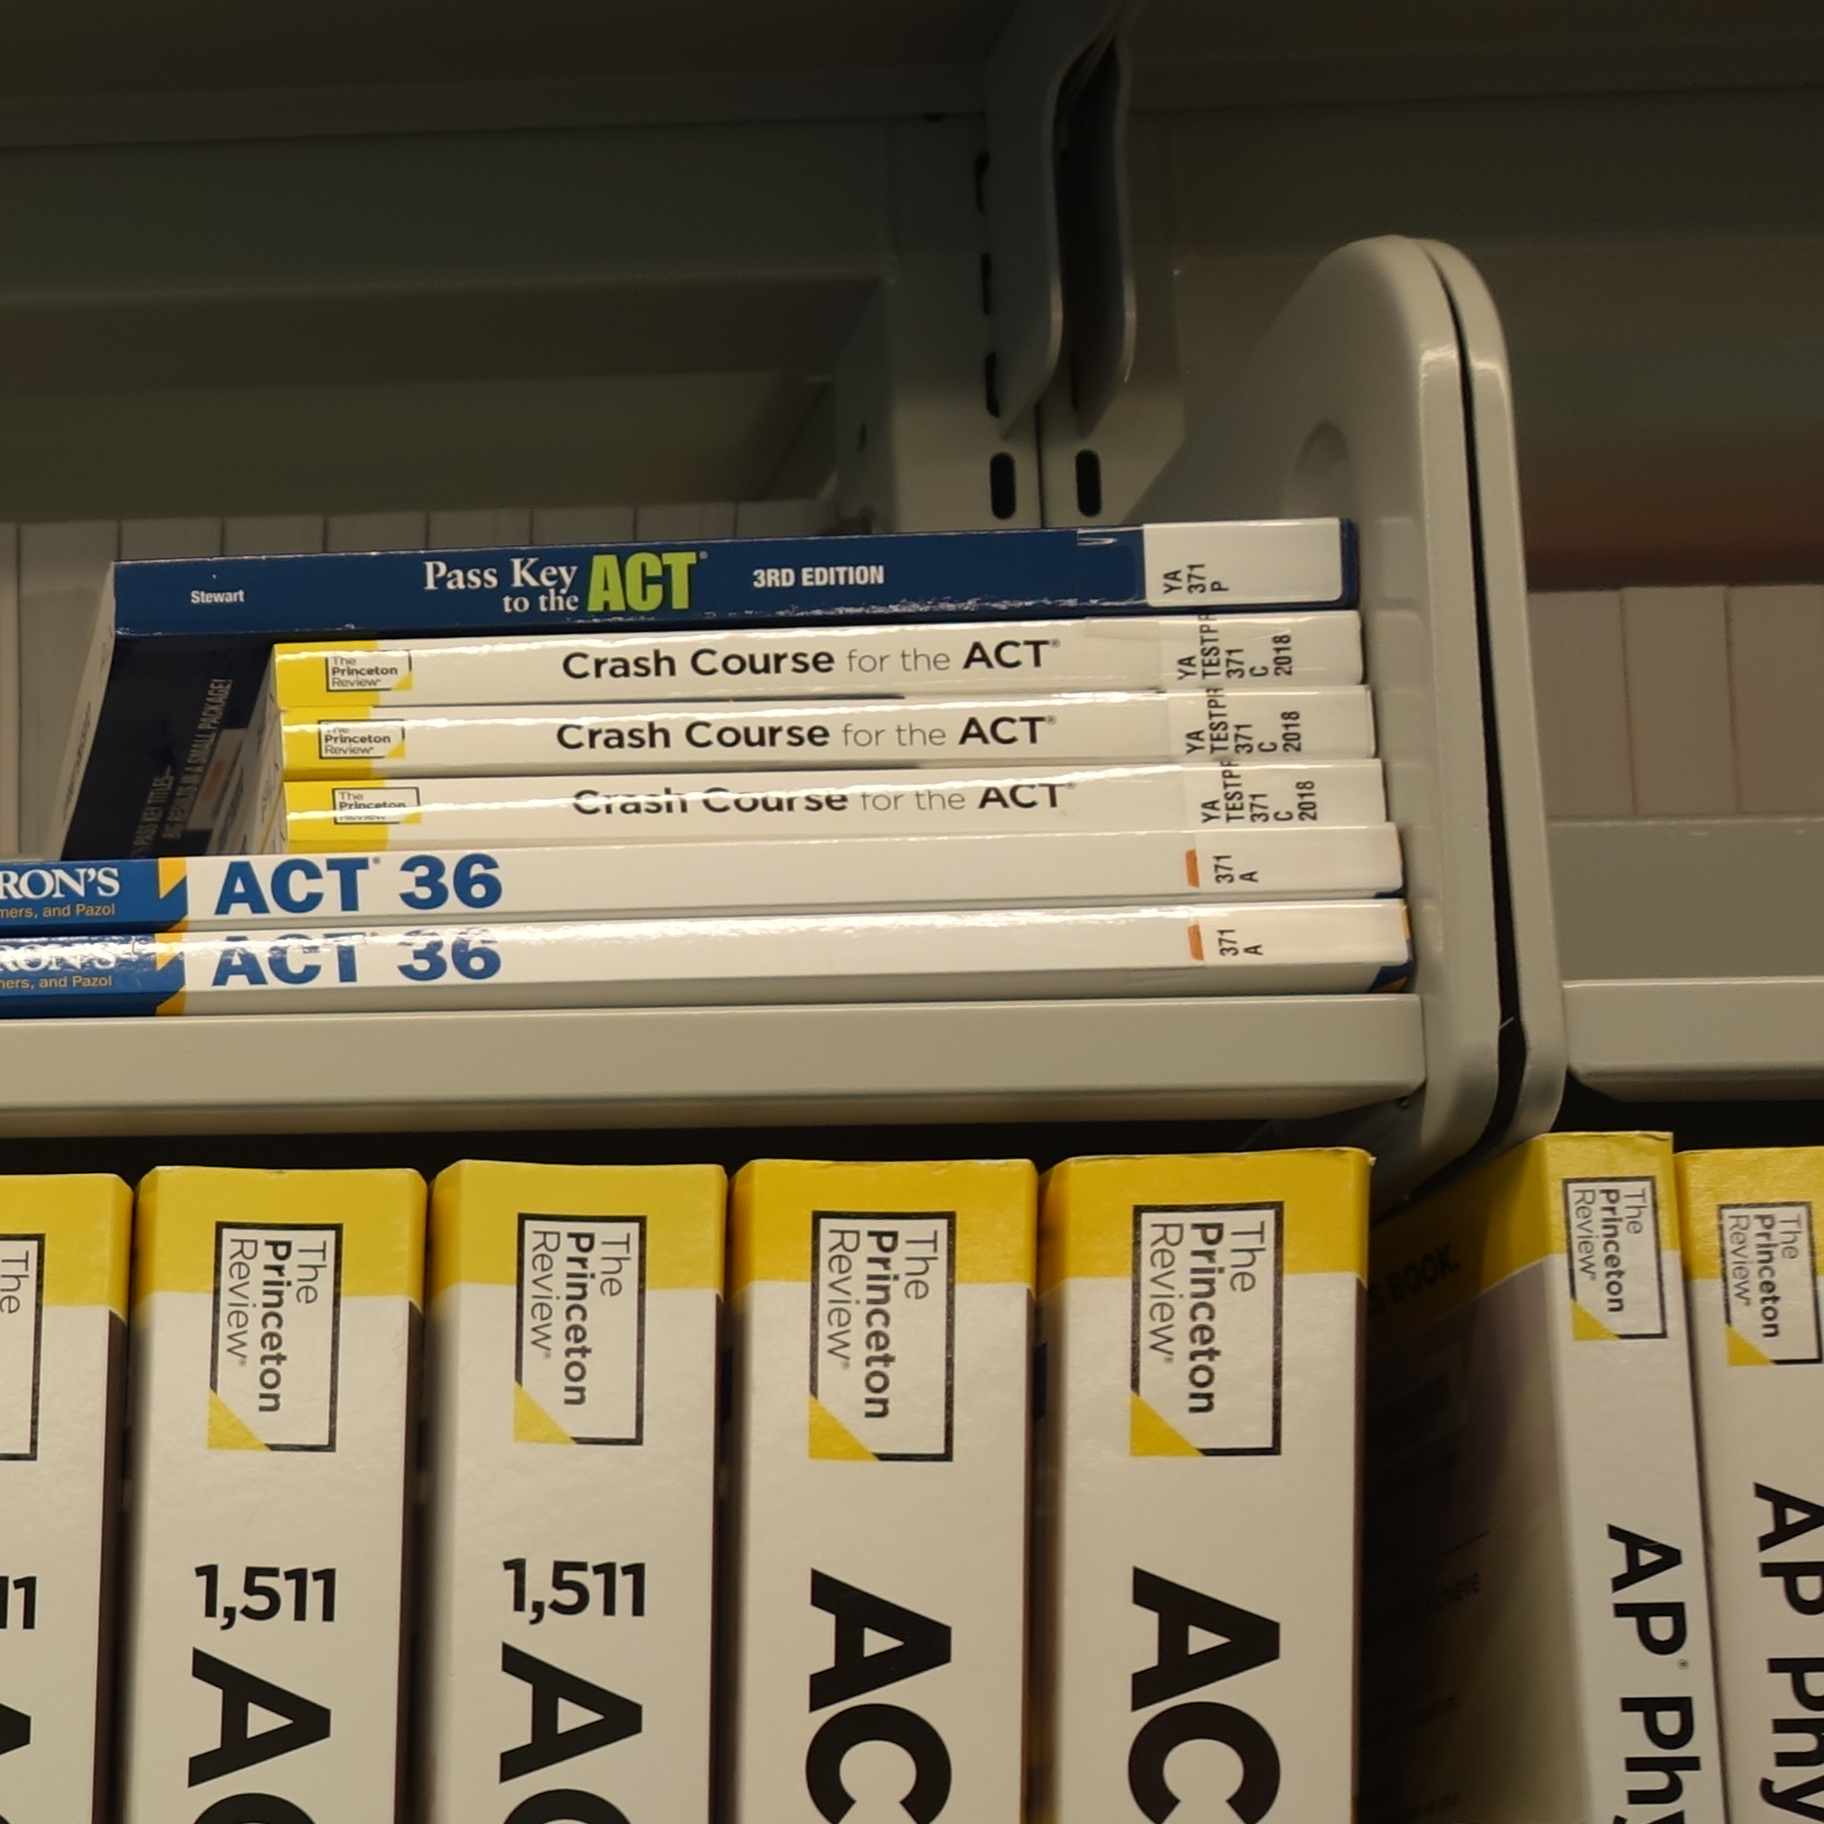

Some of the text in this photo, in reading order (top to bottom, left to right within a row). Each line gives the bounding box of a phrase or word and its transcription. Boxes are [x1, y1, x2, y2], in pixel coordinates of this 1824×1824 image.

[424, 557, 578, 595] Pass Key
[752, 565, 885, 589] 3RD EDITION
[1162, 569, 1183, 595] YA
[1186, 563, 1207, 595] 371
[1210, 580, 1230, 593] P
[190, 589, 245, 605] Stewart
[501, 582, 579, 615] to the
[561, 644, 678, 681] Crash
[690, 648, 835, 677] Course
[846, 648, 891, 674] for
[899, 647, 951, 673] the
[1176, 655, 1198, 681] YA
[1225, 648, 1246, 679] 371
[1271, 634, 1293, 677] 2018
[331, 666, 399, 677] Princeton
[1248, 665, 1270, 678] C
[197, 677, 234, 731] PACKAGE!
[556, 720, 947, 750] Crash Course for the
[399, 853, 503, 911] 36
[1212, 854, 1235, 884] 371
[1238, 870, 1259, 883] A
[42, 904, 72, 918] and
[74, 903, 116, 917] Pazol
[1616, 1180, 1656, 1242] The
[1229, 1220, 1267, 1293] The
[1599, 1188, 1626, 1313] Princeton
[1187, 1222, 1225, 1414] Princeton
[502, 1557, 646, 1626] 1,511
